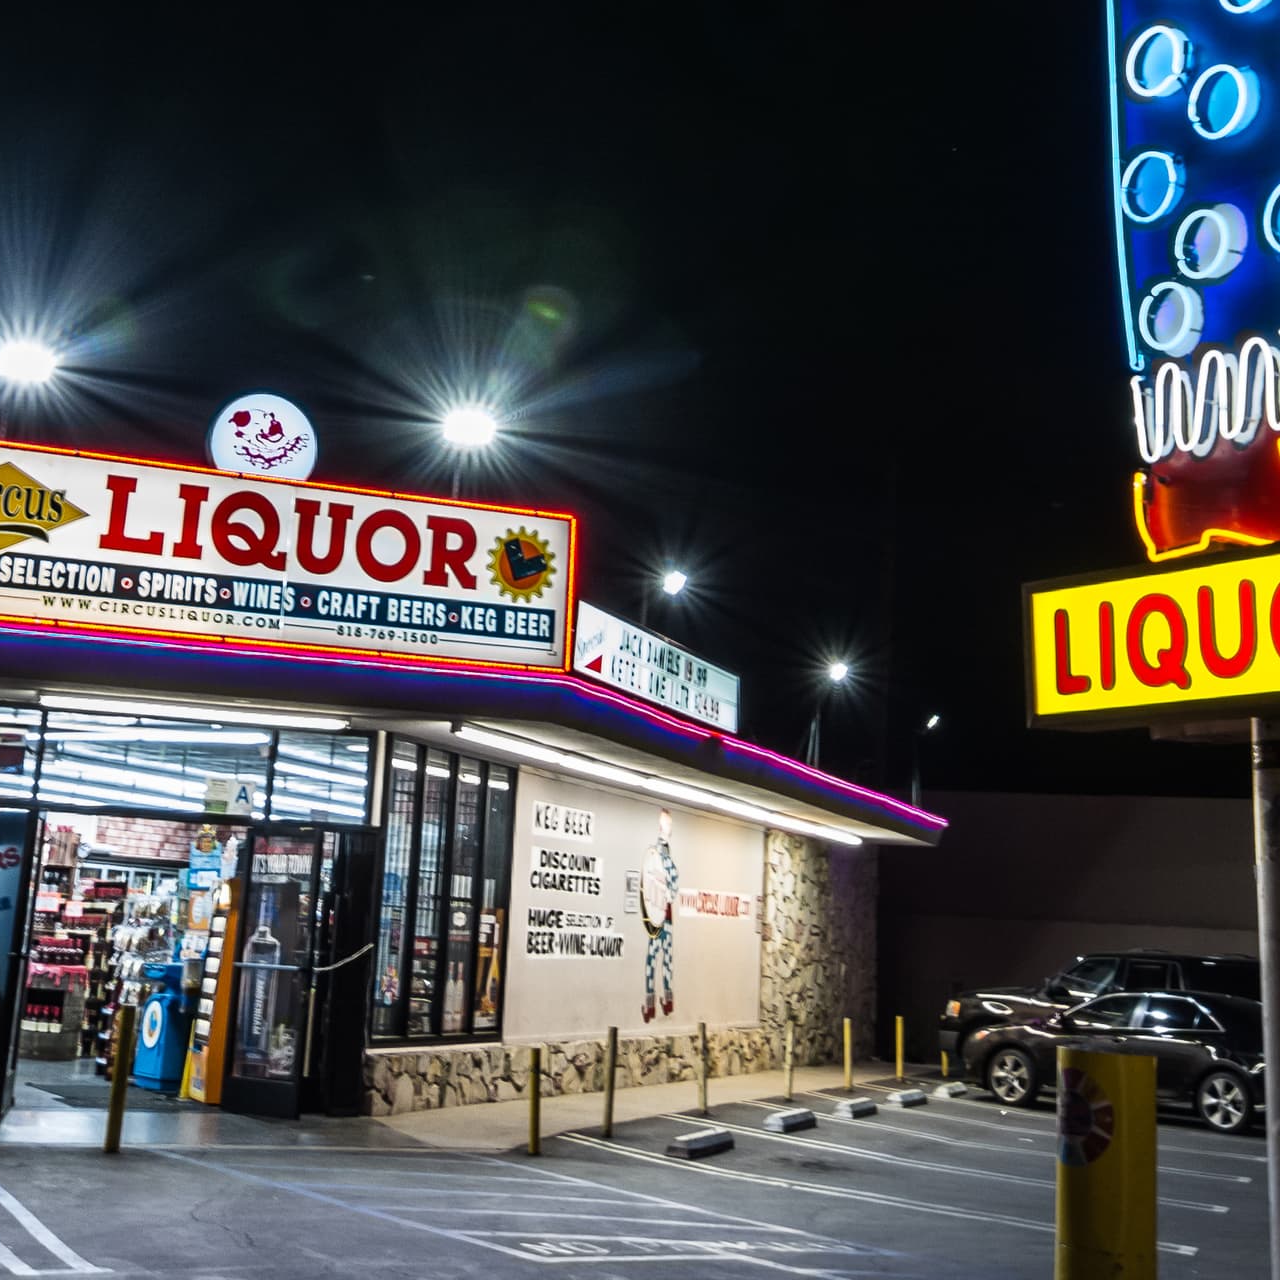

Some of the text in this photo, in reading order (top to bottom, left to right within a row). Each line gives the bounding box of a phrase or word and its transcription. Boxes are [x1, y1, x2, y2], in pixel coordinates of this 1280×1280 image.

[99, 475, 477, 590] LIQUOR
[40, 594, 280, 630] WWW.CIRCUSLIQUOR.COM
[137, 570, 218, 604] SPIRITS
[233, 581, 296, 612] WINES
[317, 589, 380, 620] CRAFT
[387, 599, 447, 627] BEERS
[460, 606, 497, 633] KEG
[504, 611, 551, 638] BEER
[534, 803, 592, 836] KEG BEER
[540, 849, 596, 873] DISCOUNT
[530, 870, 600, 896] CIGARETTES
[528, 907, 564, 929] HUGE
